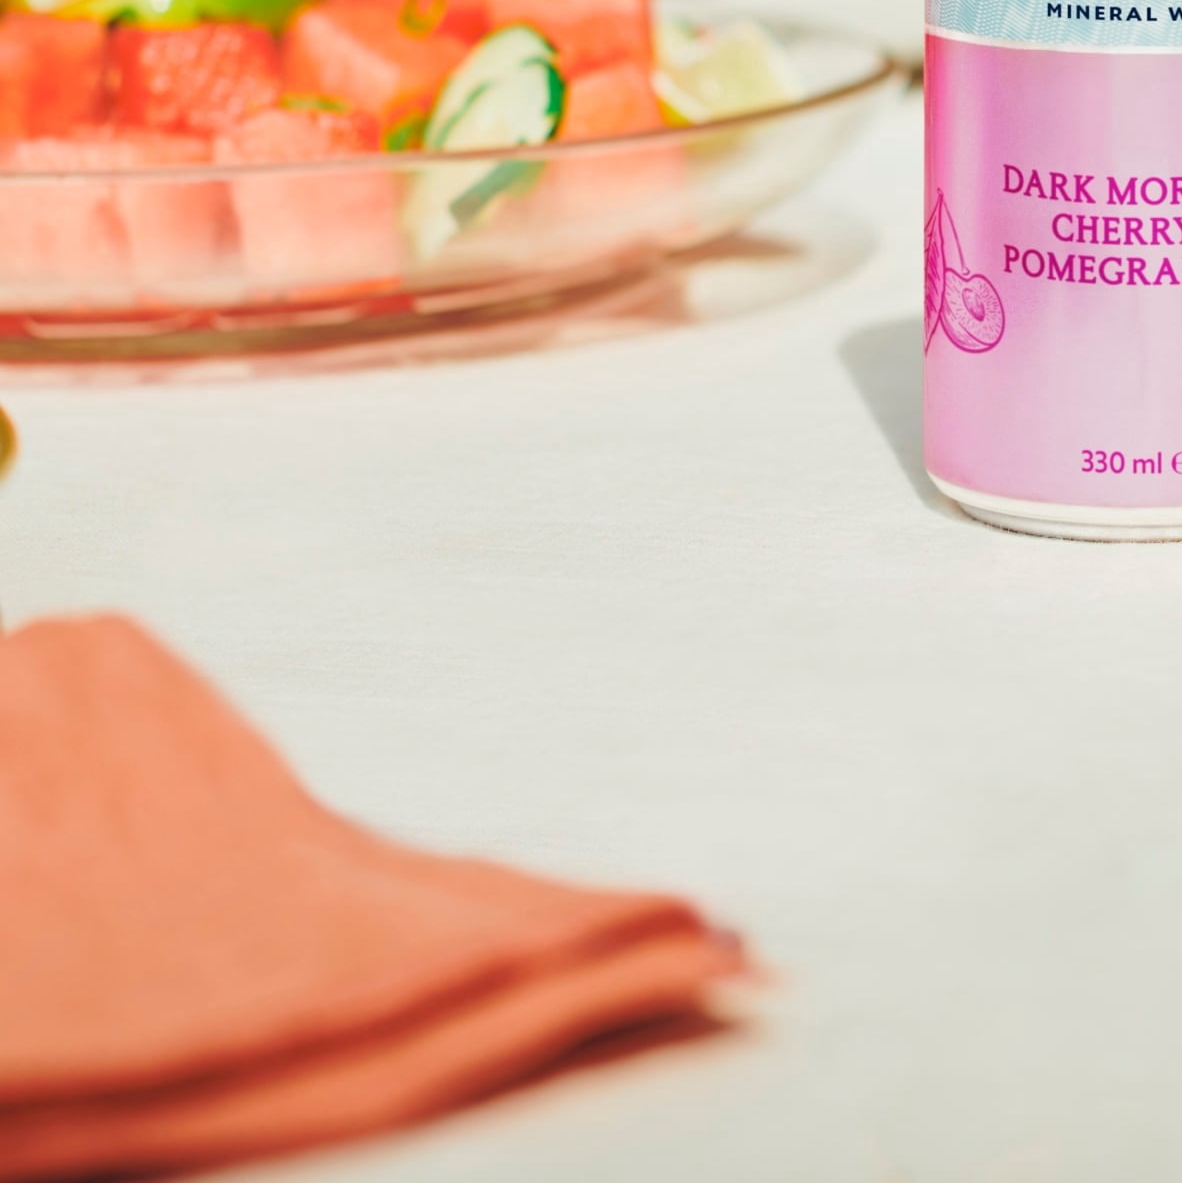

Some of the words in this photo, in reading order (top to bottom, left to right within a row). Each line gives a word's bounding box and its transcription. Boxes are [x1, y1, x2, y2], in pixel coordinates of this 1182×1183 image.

[1047, 3, 1158, 22] MINERAL
[1003, 164, 1096, 204] DARK
[1081, 449, 1125, 474] 330
[1132, 452, 1162, 474] ml
